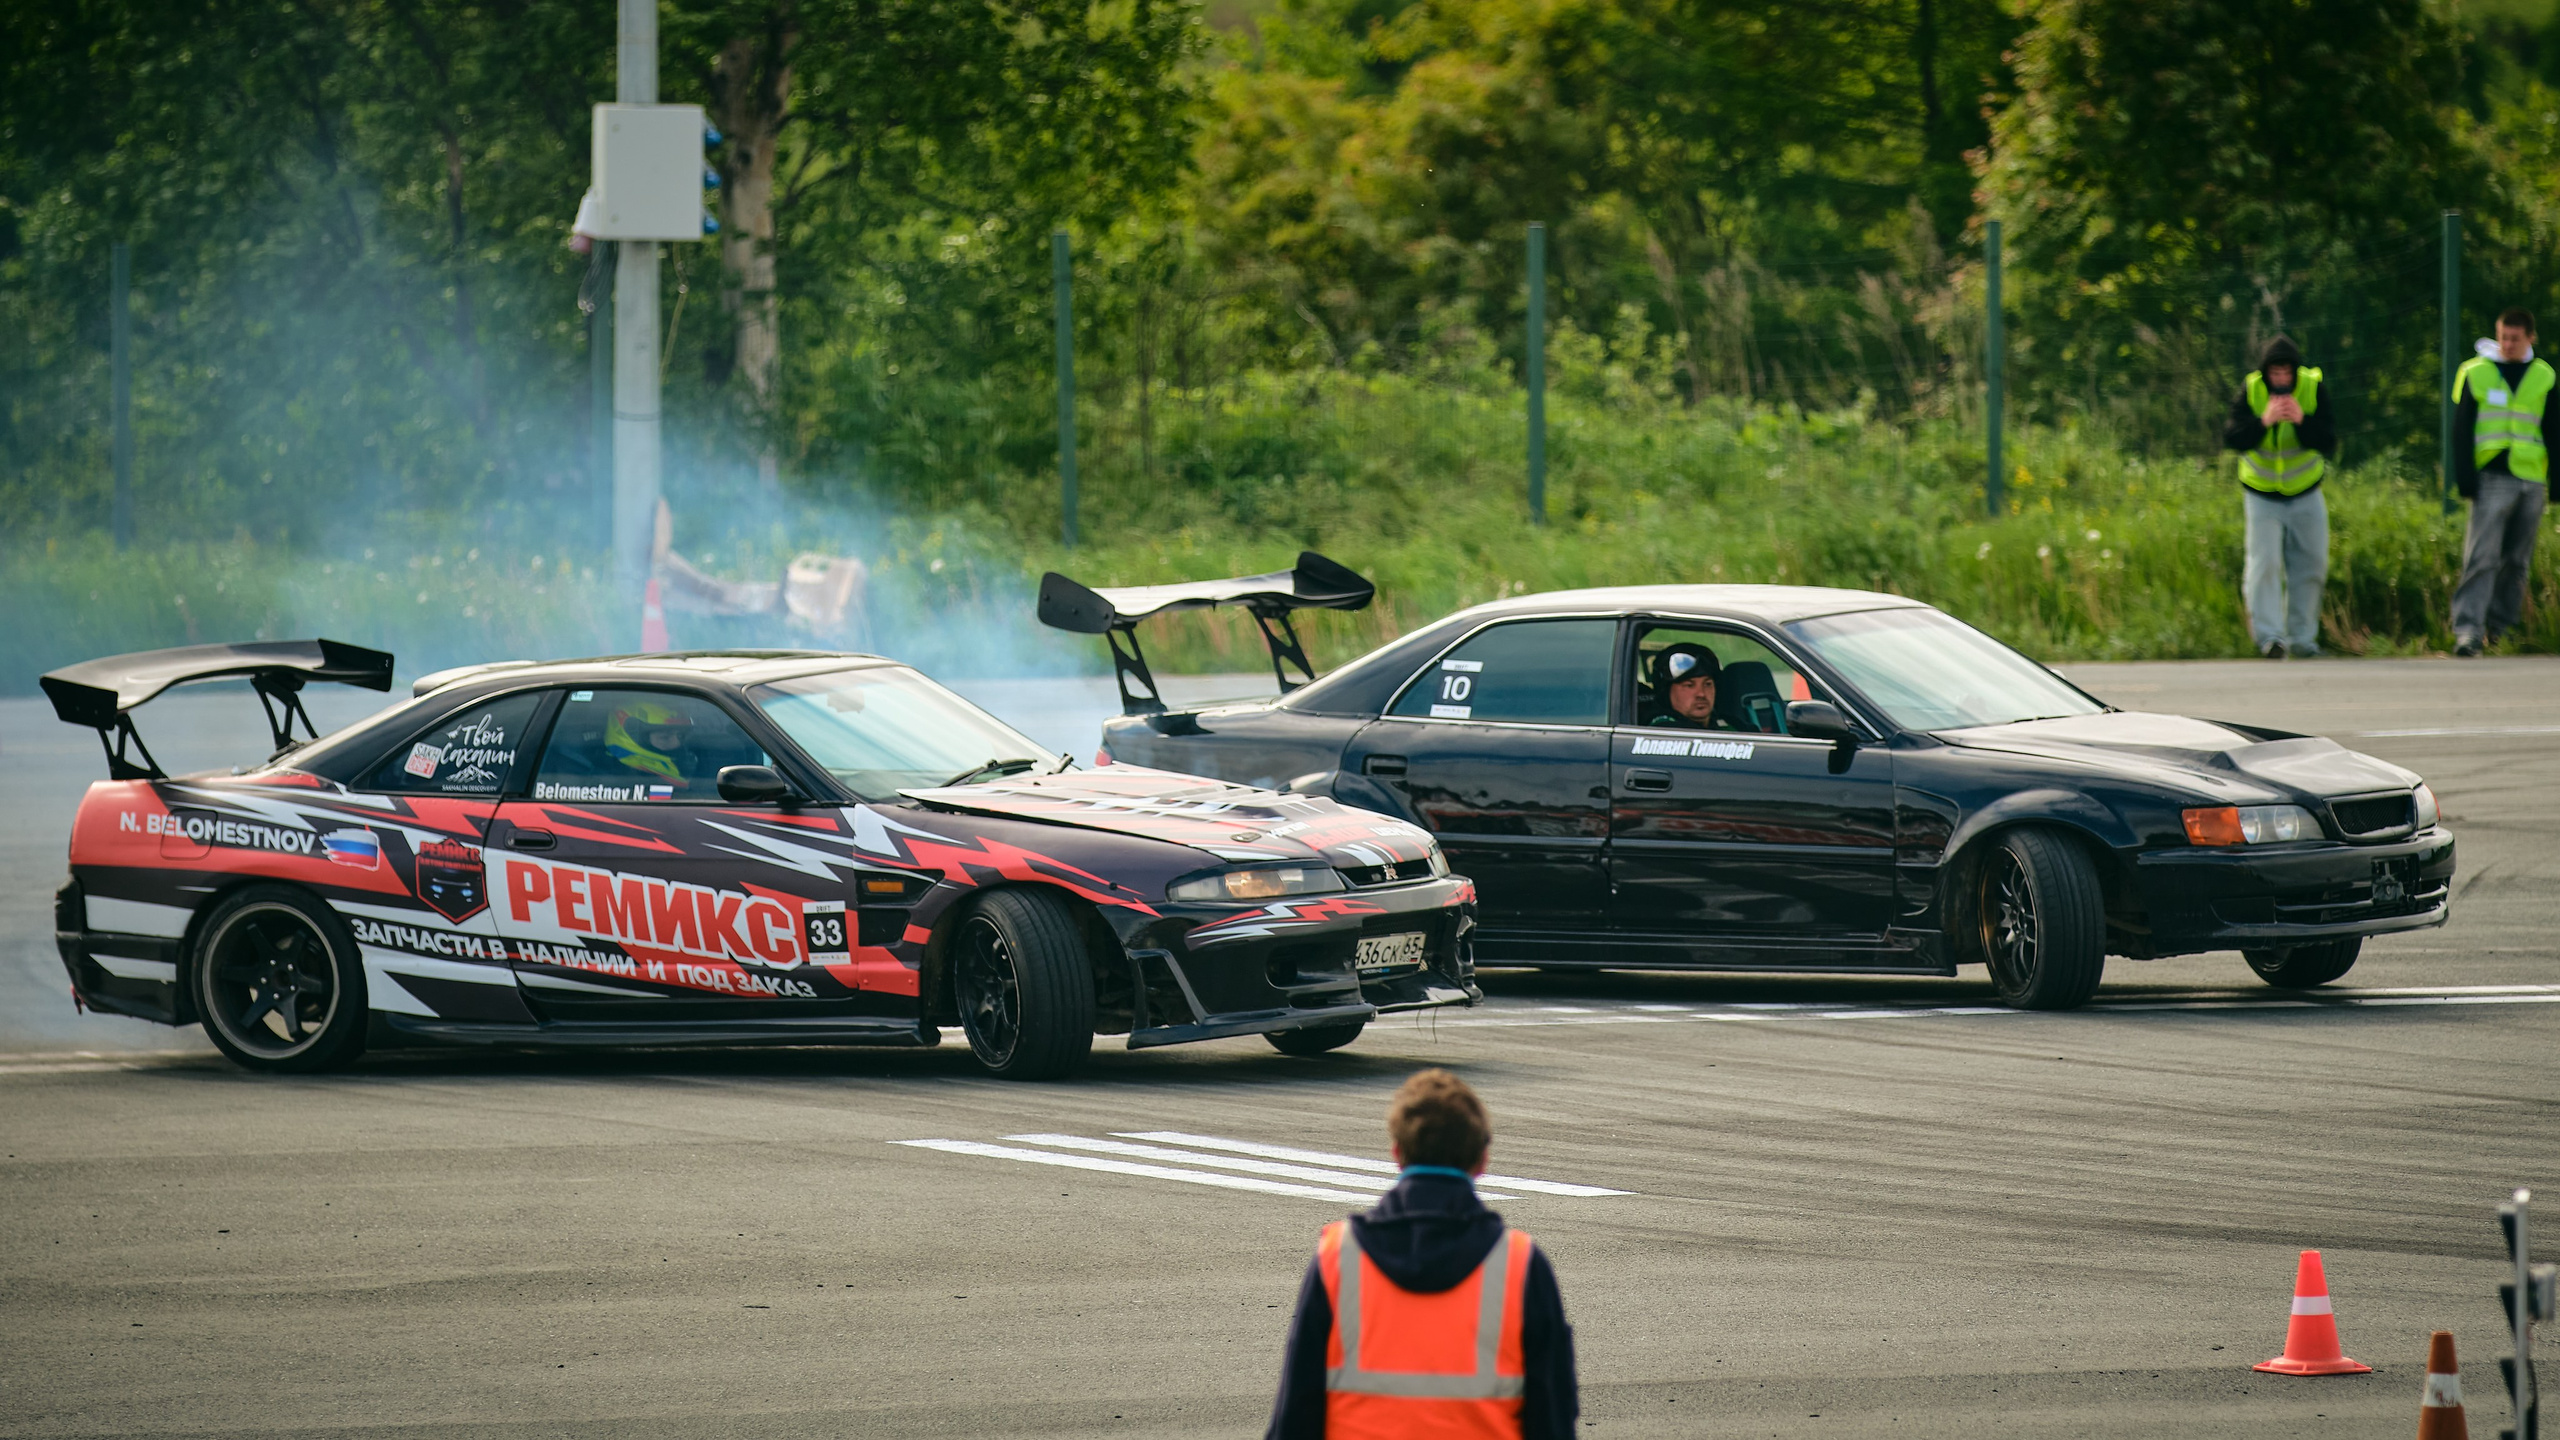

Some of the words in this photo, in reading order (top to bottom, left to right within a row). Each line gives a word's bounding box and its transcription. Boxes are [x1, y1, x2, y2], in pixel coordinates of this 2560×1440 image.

[1442, 675, 1471, 702] 10
[461, 714, 505, 747] Твой
[440, 741, 515, 768] Сахалин
[1631, 736, 1692, 756] Холявин
[1690, 738, 1756, 760] Тимофей
[535, 782, 630, 801] Belomestnov
[632, 784, 648, 801] N.
[119, 811, 142, 833] N.
[146, 813, 316, 855] BELOMESTNOV
[505, 859, 798, 965] РЕМИКС
[810, 918, 843, 947] 33
[1403, 937, 1420, 955] 65
[350, 918, 486, 960] ЗАПЧАСТИ
[487, 938, 508, 961] В
[516, 940, 637, 977] НАЛИЧИИ
[646, 958, 667, 981] И
[676, 963, 737, 992] ПОД
[736, 972, 817, 998] ЗАКАЗ
